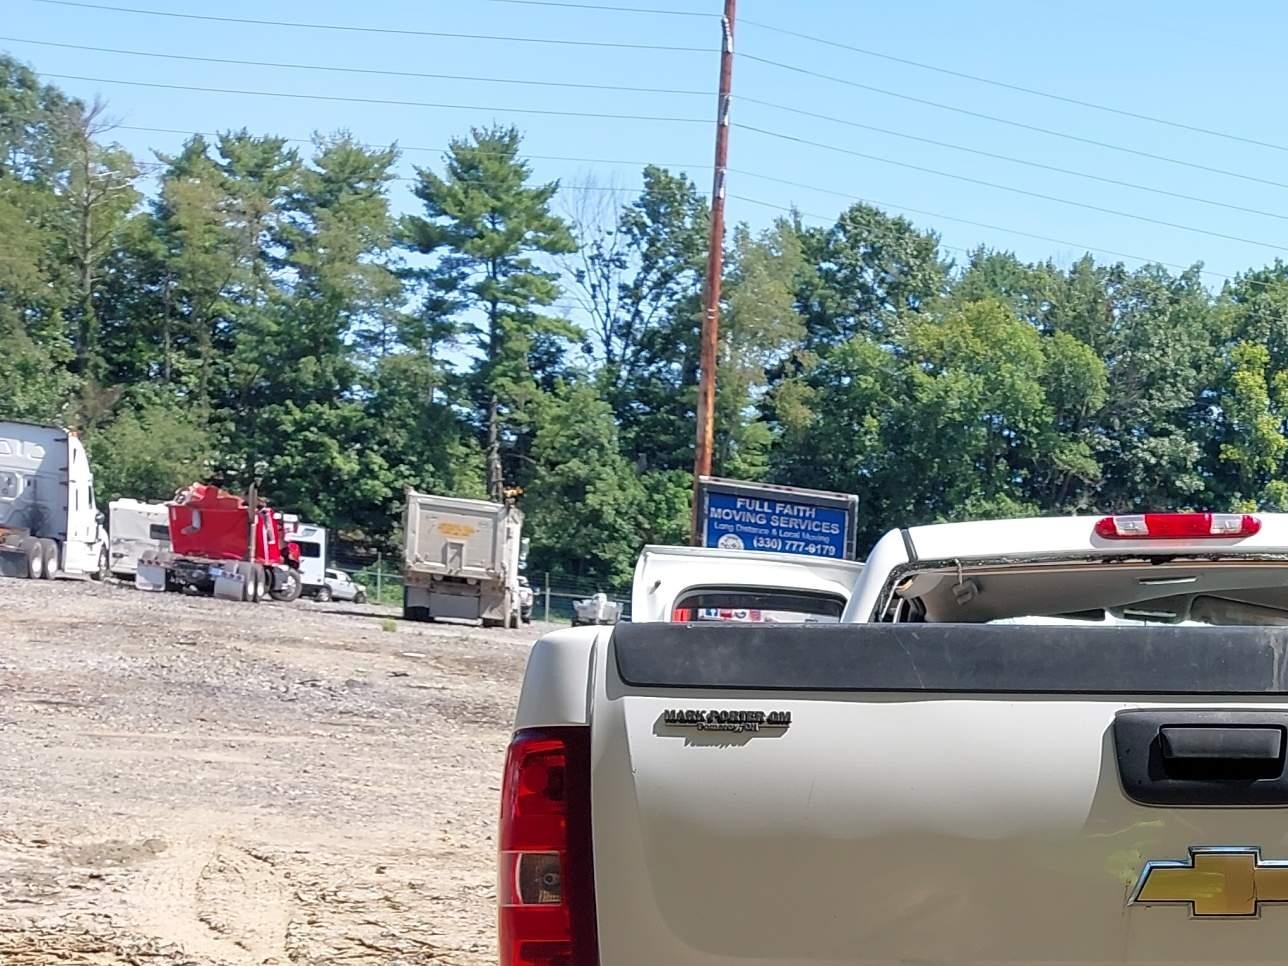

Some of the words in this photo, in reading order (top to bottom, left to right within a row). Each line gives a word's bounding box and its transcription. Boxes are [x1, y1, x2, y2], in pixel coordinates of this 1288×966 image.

[736, 498, 772, 513] FULL
[775, 503, 816, 518] FAITH
[709, 508, 767, 525] MOVING
[770, 515, 840, 534] SERVICES
[714, 521, 735, 533] Long
[736, 523, 770, 535] Distance
[771, 529, 778, 537] &
[779, 529, 800, 540] Local
[802, 532, 830, 544] Moving
[753, 536, 782, 551] (330)
[664, 709, 706, 723] MARK
[707, 710, 765, 724] PORTER
